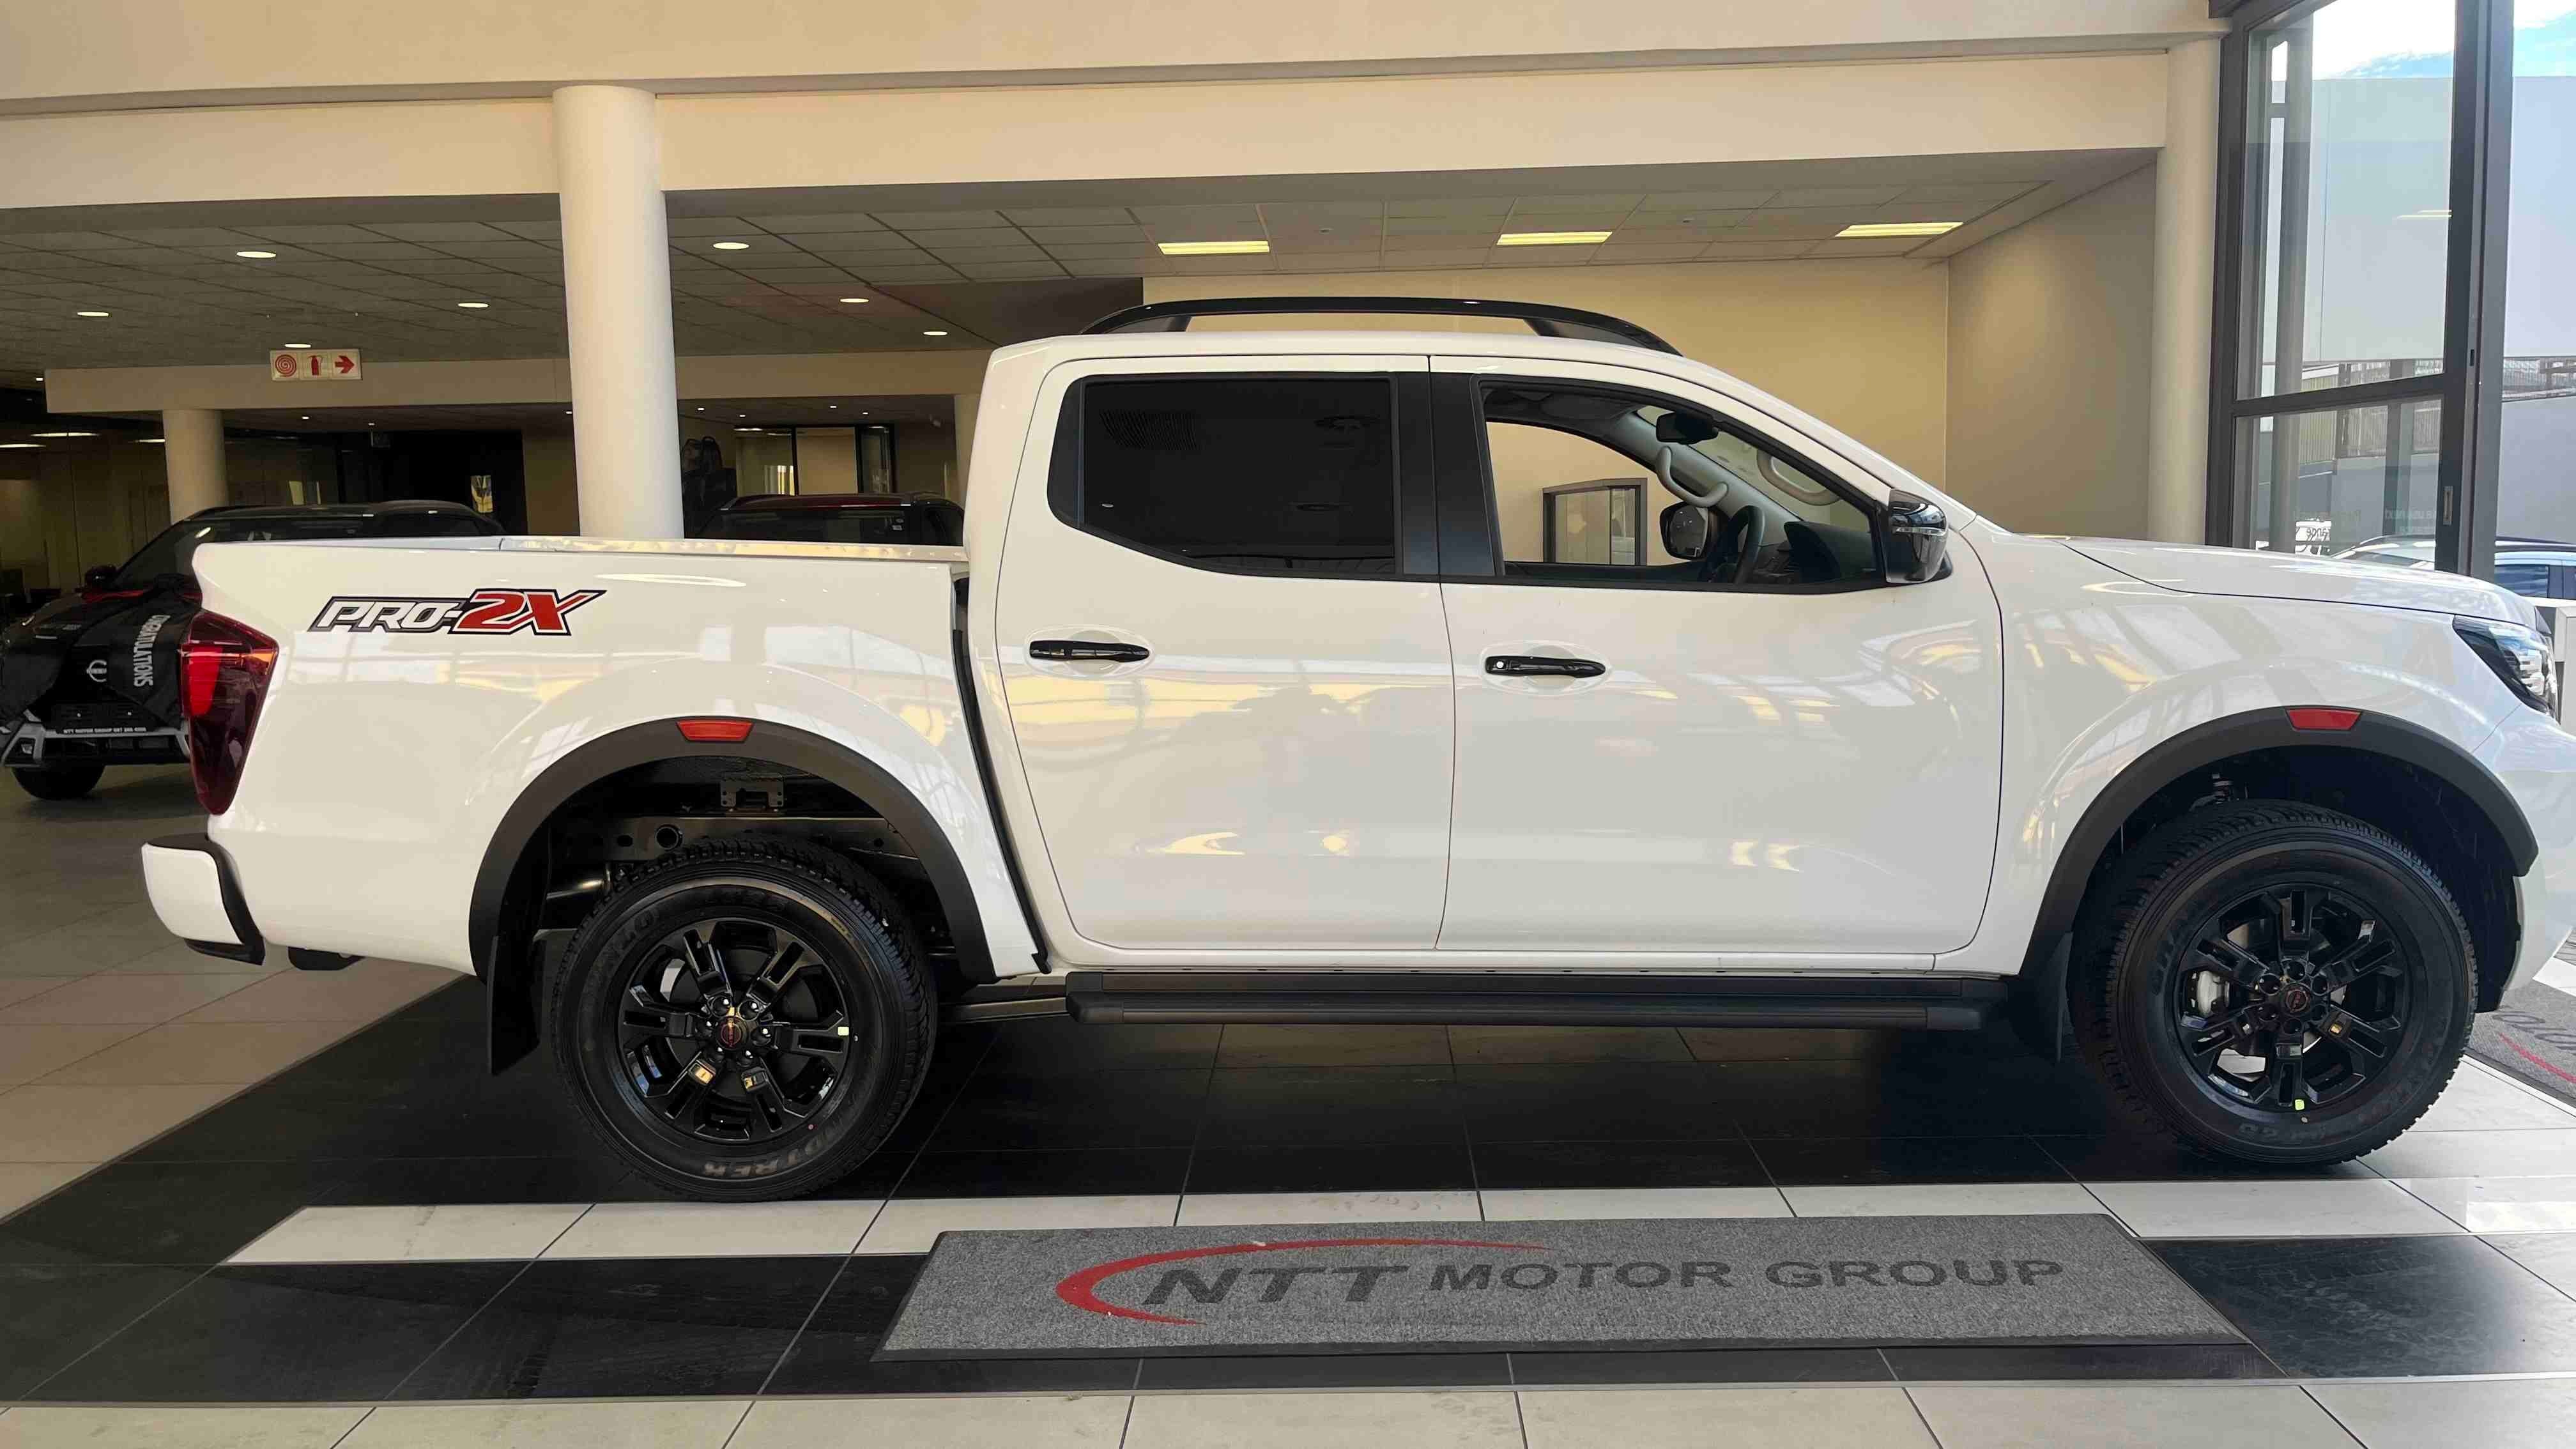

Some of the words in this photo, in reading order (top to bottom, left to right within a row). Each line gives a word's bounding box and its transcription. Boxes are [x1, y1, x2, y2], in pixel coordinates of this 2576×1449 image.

[307, 588, 608, 636] PRO-2X
[1141, 1266, 1411, 1304] NTT
[1430, 1261, 1734, 1291] MOTOR
[1765, 1260, 2063, 1287] GROUP
